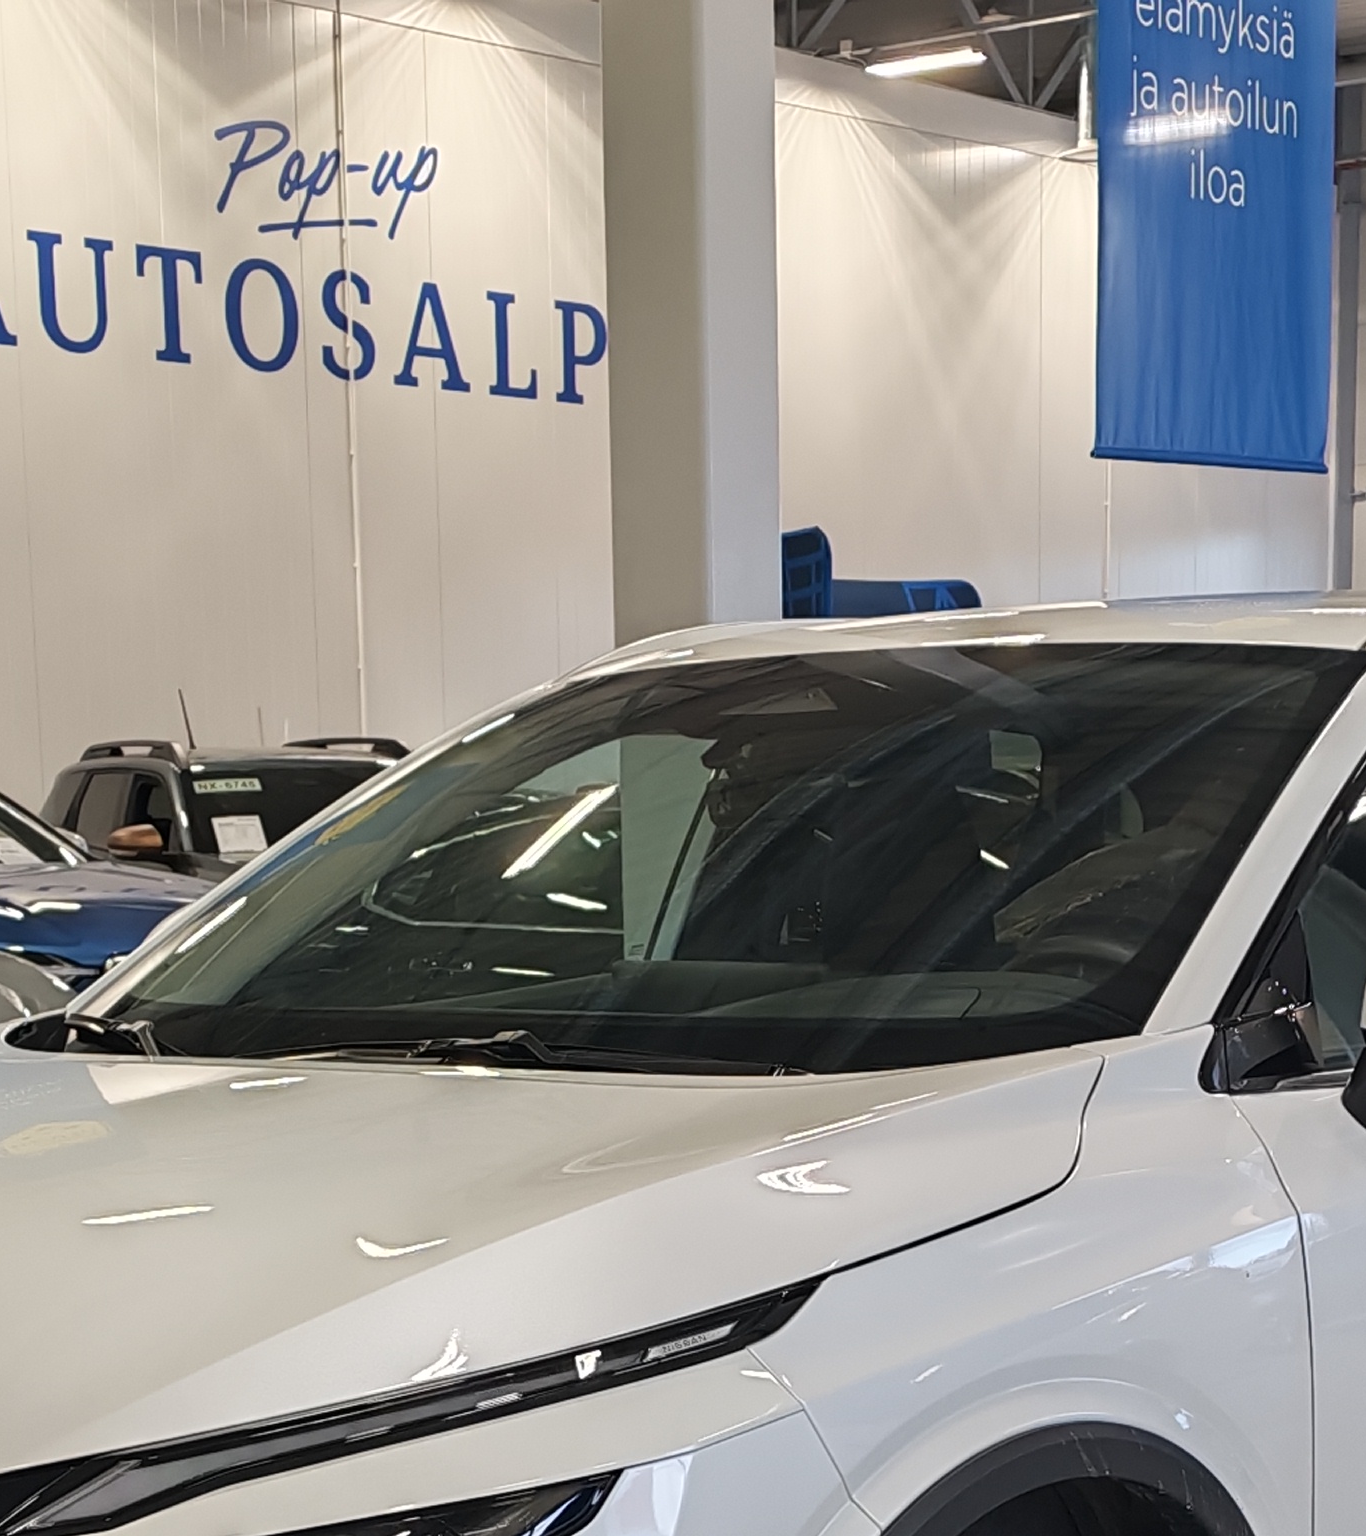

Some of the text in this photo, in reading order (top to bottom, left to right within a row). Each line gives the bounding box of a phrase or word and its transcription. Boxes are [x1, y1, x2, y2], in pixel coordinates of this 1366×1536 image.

[1130, 54, 1298, 138] ja autoilun
[214, 120, 439, 240] Pop-up
[1190, 148, 1245, 207] iloa
